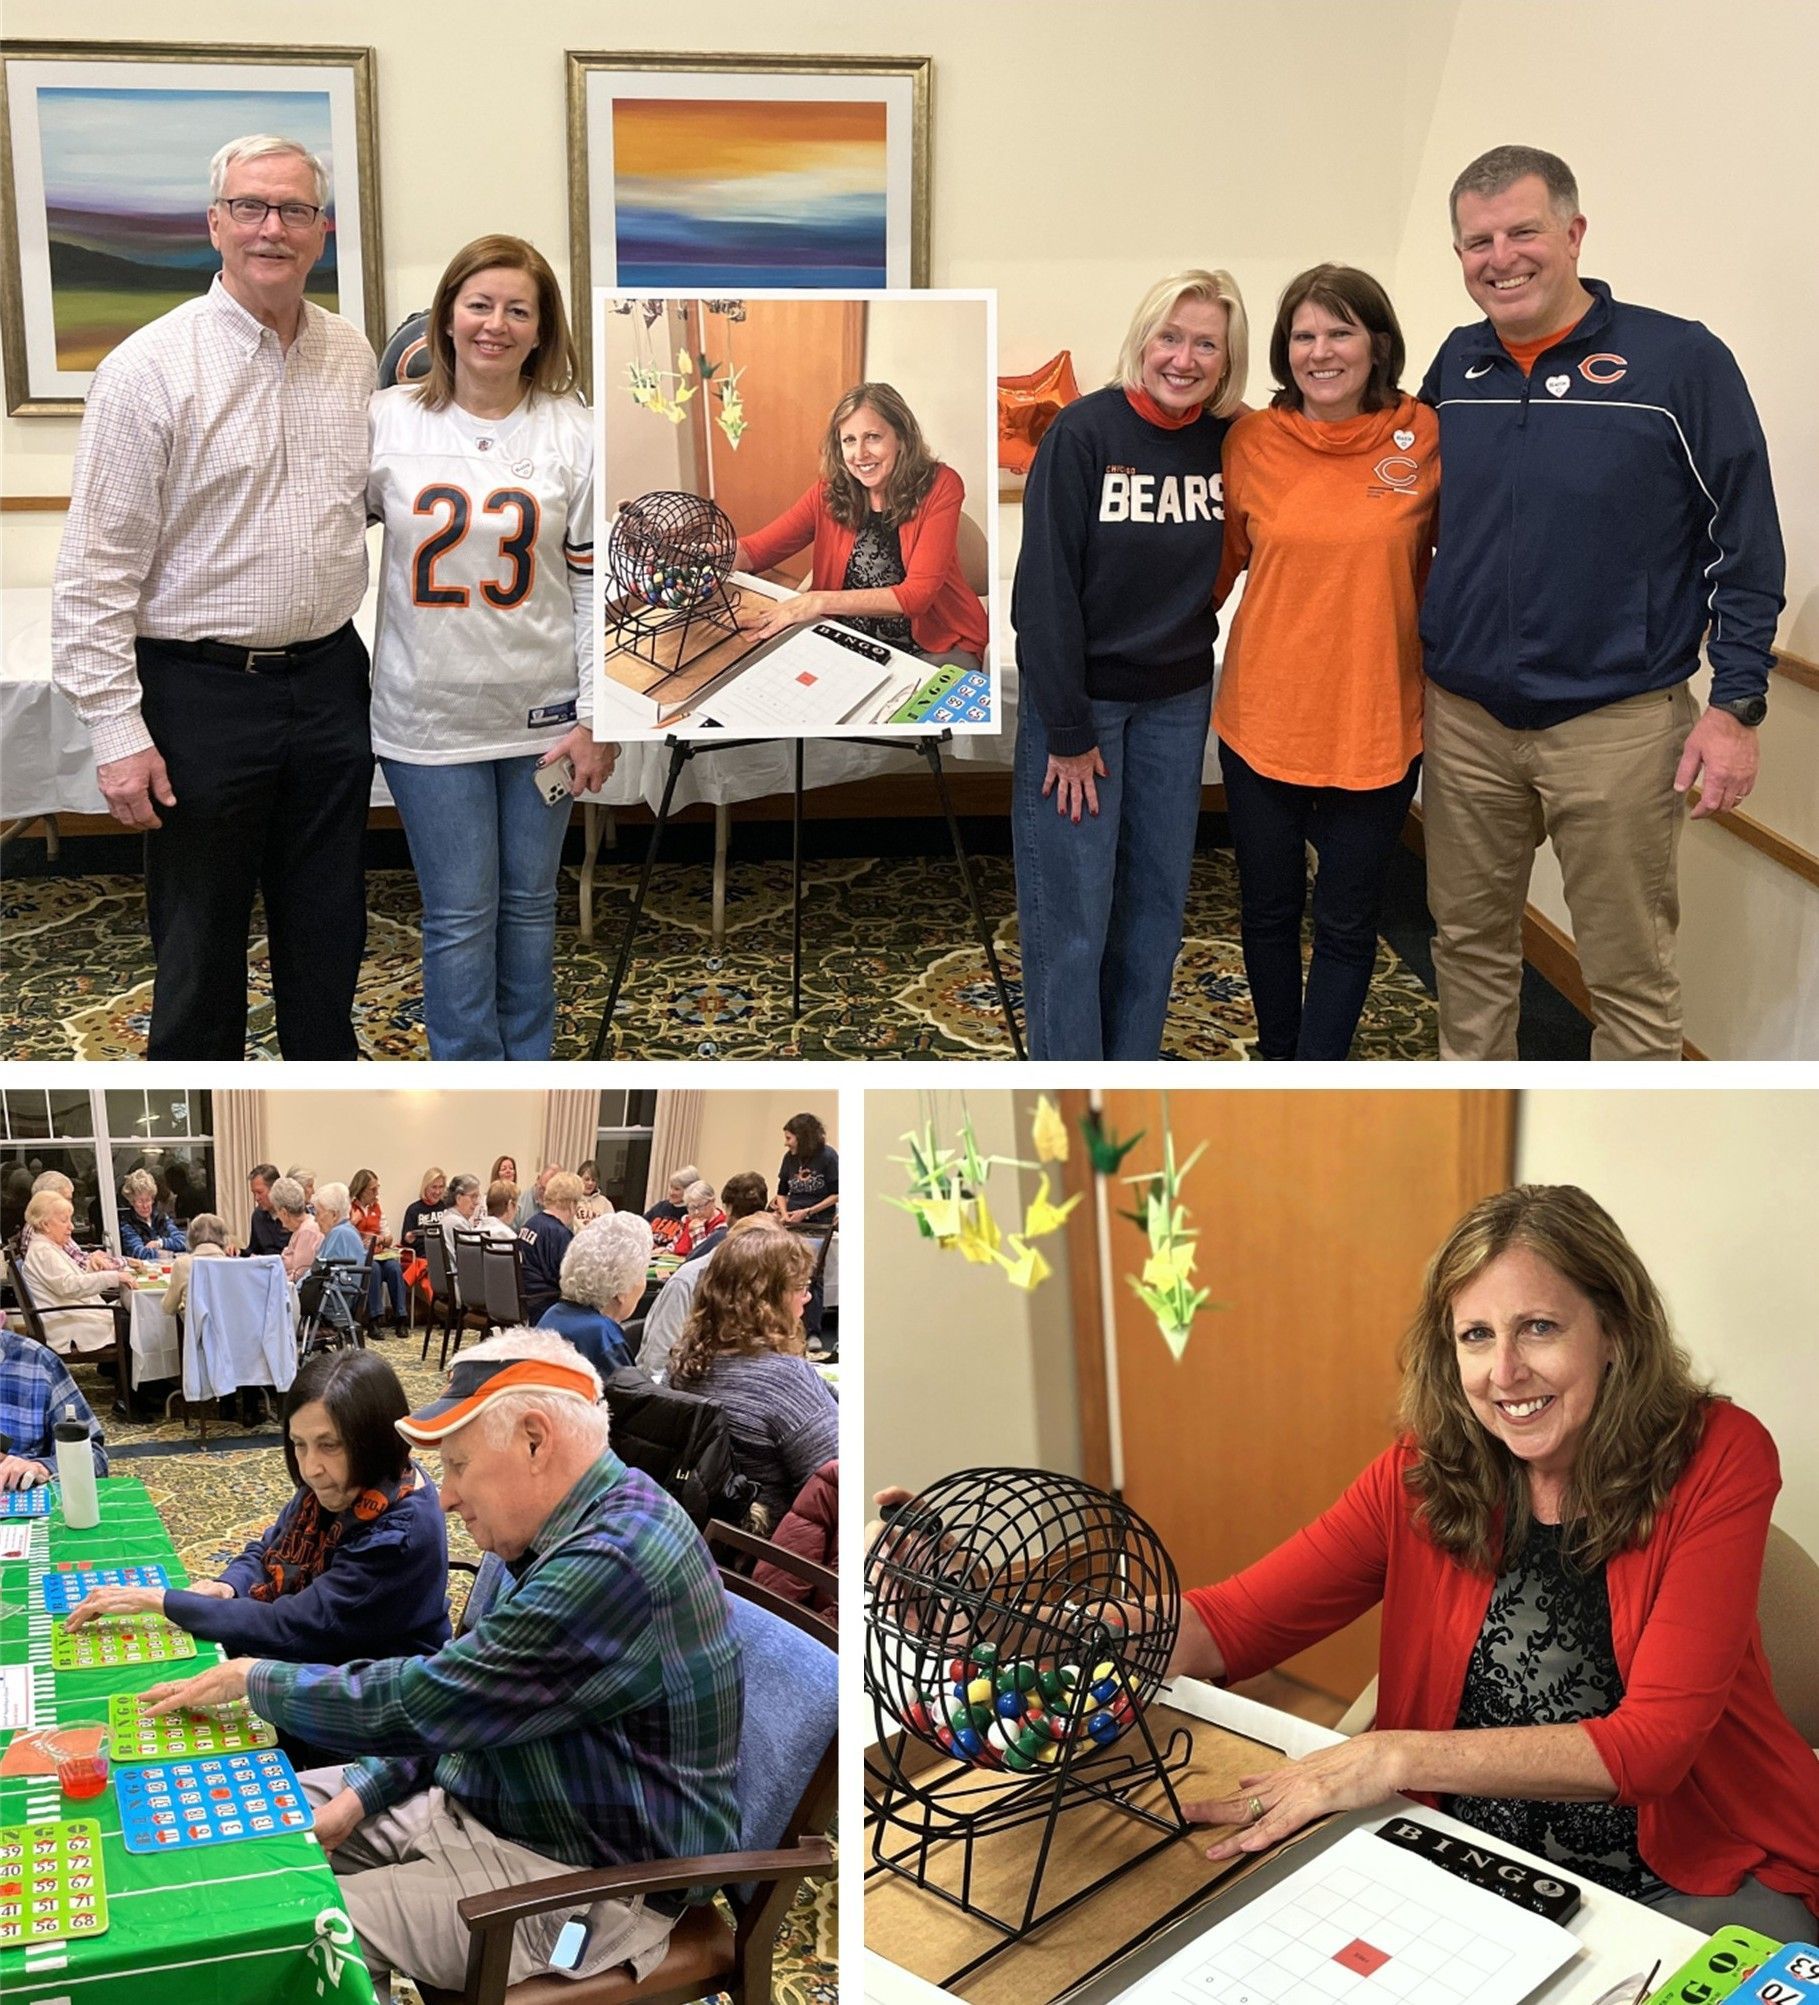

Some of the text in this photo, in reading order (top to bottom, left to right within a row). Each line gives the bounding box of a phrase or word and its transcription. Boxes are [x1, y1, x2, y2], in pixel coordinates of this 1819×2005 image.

[412, 483, 541, 610] 23
[819, 627, 886, 655] BINGO
[225, 1823, 241, 1832] 3
[255, 1818, 272, 1829] 13
[1, 1839, 88, 1858] 39 57 62
[0, 1858, 89, 1877] 40 55 72
[1393, 1824, 1565, 1897] BINGO
[36, 1876, 91, 1892] 59 67
[1, 1895, 91, 1916] 41 51 71
[1, 1915, 95, 1938] 31 56 68
